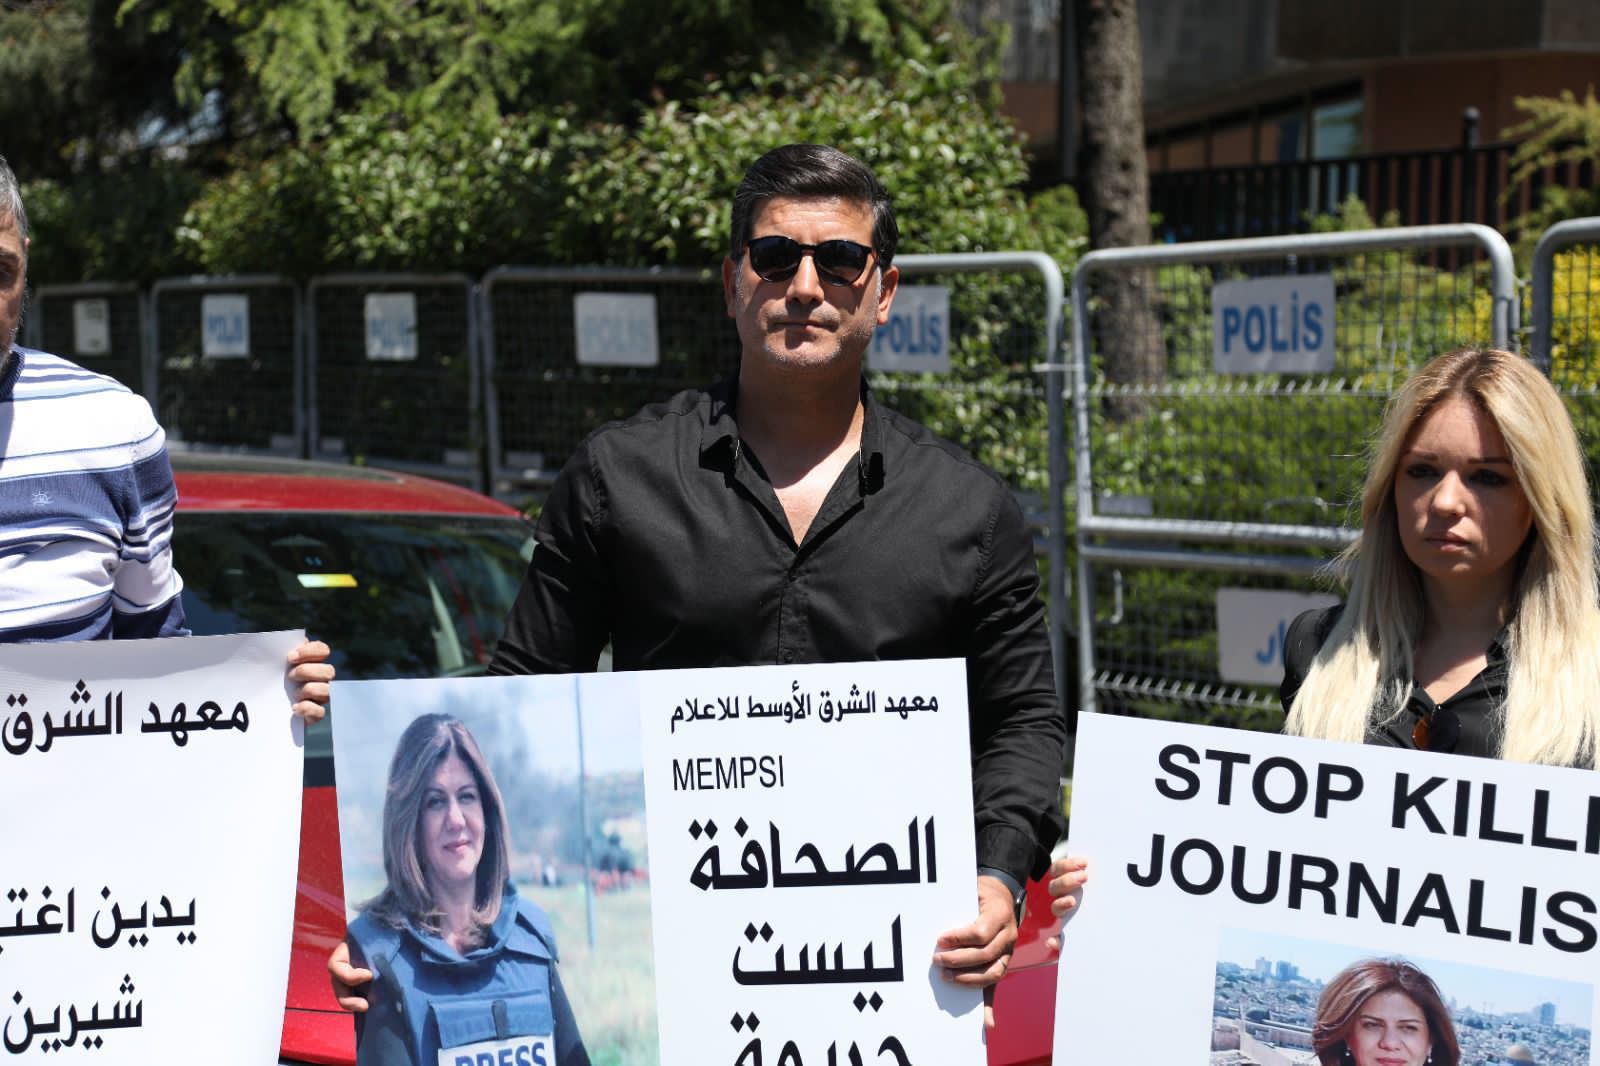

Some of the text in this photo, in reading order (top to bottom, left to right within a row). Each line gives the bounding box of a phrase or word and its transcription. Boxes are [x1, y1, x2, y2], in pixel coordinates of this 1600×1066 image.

[1222, 289, 1325, 354] POLİS
[2, 679, 249, 755] معهد الشرق
[746, 679, 811, 724] الأوسط
[818, 684, 876, 723] الشرق
[884, 695, 939, 720] معهد
[672, 755, 784, 791] MEMPSI
[1155, 743, 1600, 854] STOP KILLI
[689, 816, 937, 890] الصحافة
[0, 885, 197, 954] يدين اغت
[1127, 833, 1598, 953] JOURNALIS
[733, 915, 905, 1012] ليست
[4, 974, 143, 1055] شيرين
